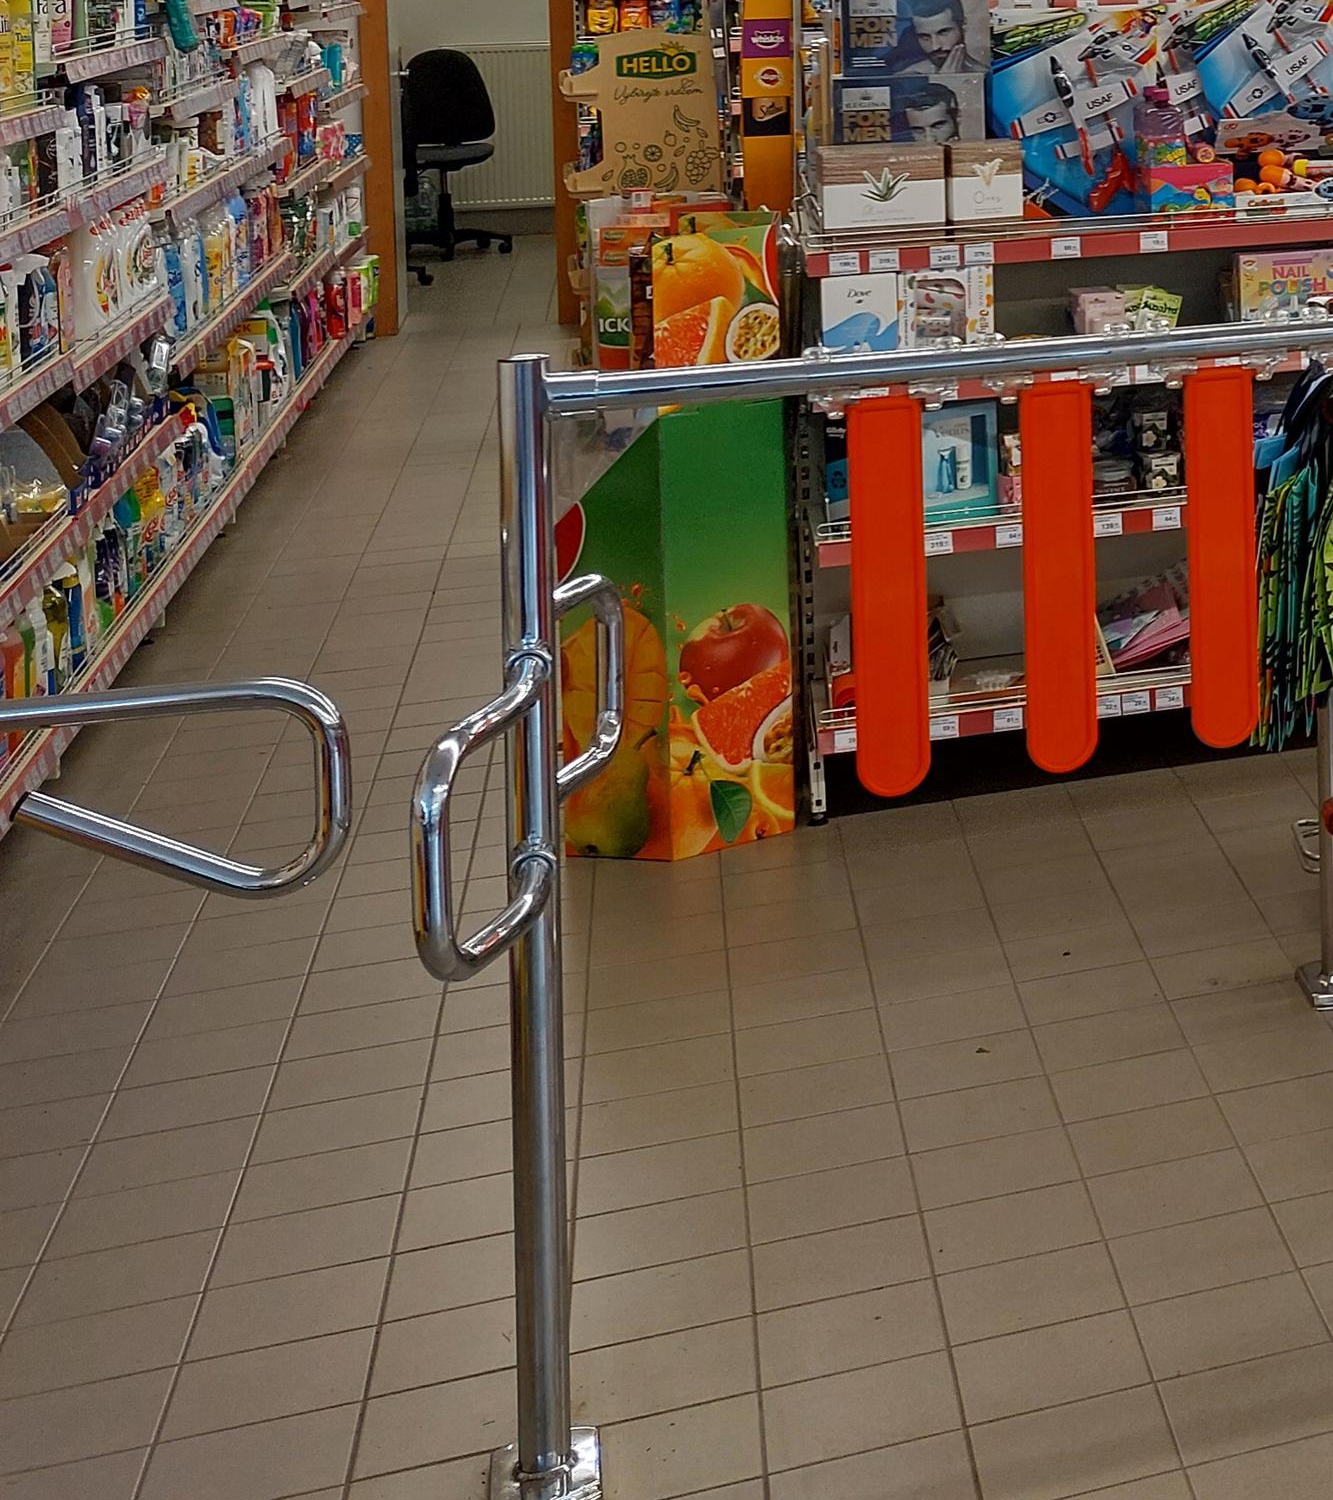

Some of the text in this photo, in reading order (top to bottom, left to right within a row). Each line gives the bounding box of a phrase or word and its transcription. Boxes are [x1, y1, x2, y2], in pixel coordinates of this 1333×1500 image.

[851, 17, 896, 32] FOR
[851, 33, 898, 48] MEN
[622, 55, 691, 75] HELLO
[1286, 55, 1309, 75] USAF
[1174, 79, 1198, 96] USAF
[1086, 93, 1113, 110] USAF
[843, 111, 890, 126] FOR
[843, 127, 890, 142] MEN
[1272, 266, 1309, 279] NAIL
[847, 288, 872, 298] Dove
[1258, 279, 1327, 296] POLISH
